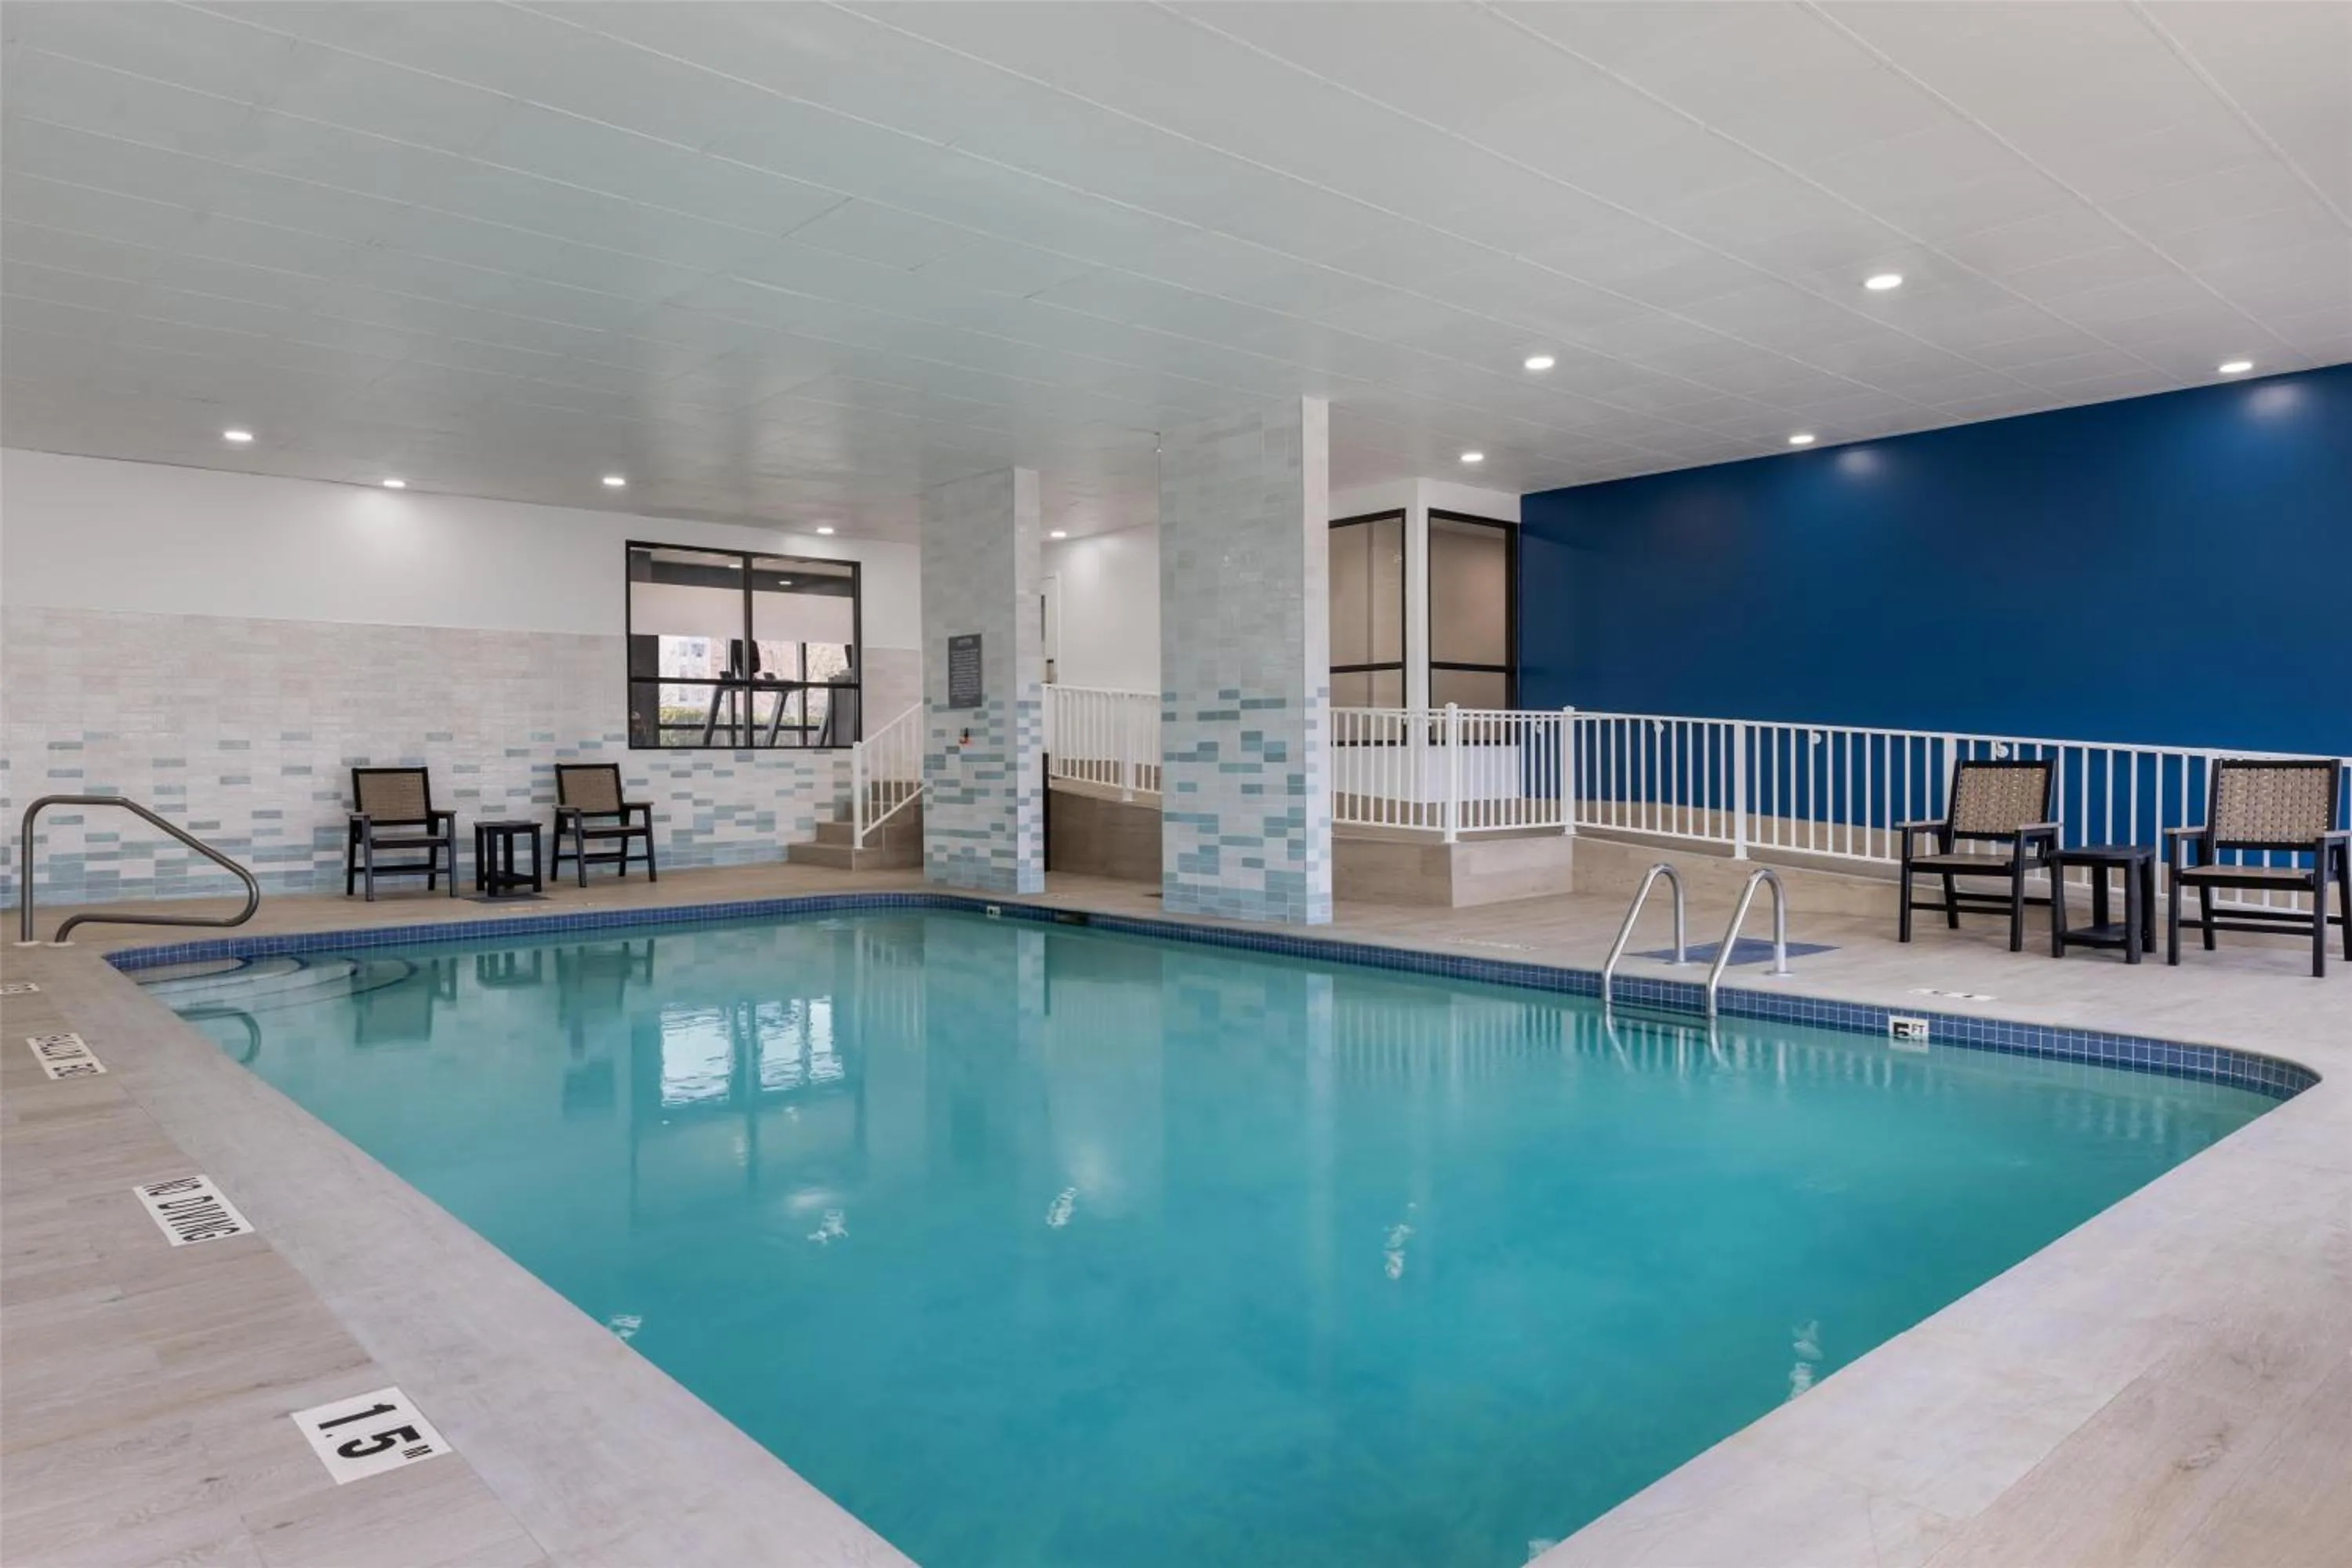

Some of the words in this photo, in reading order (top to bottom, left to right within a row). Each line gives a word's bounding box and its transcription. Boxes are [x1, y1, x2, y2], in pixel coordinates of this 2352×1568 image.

[1893, 1022, 1910, 1039] 5
[143, 1178, 202, 1196] NO
[158, 1195, 241, 1242] DIVING
[318, 1403, 421, 1458] 1.5
